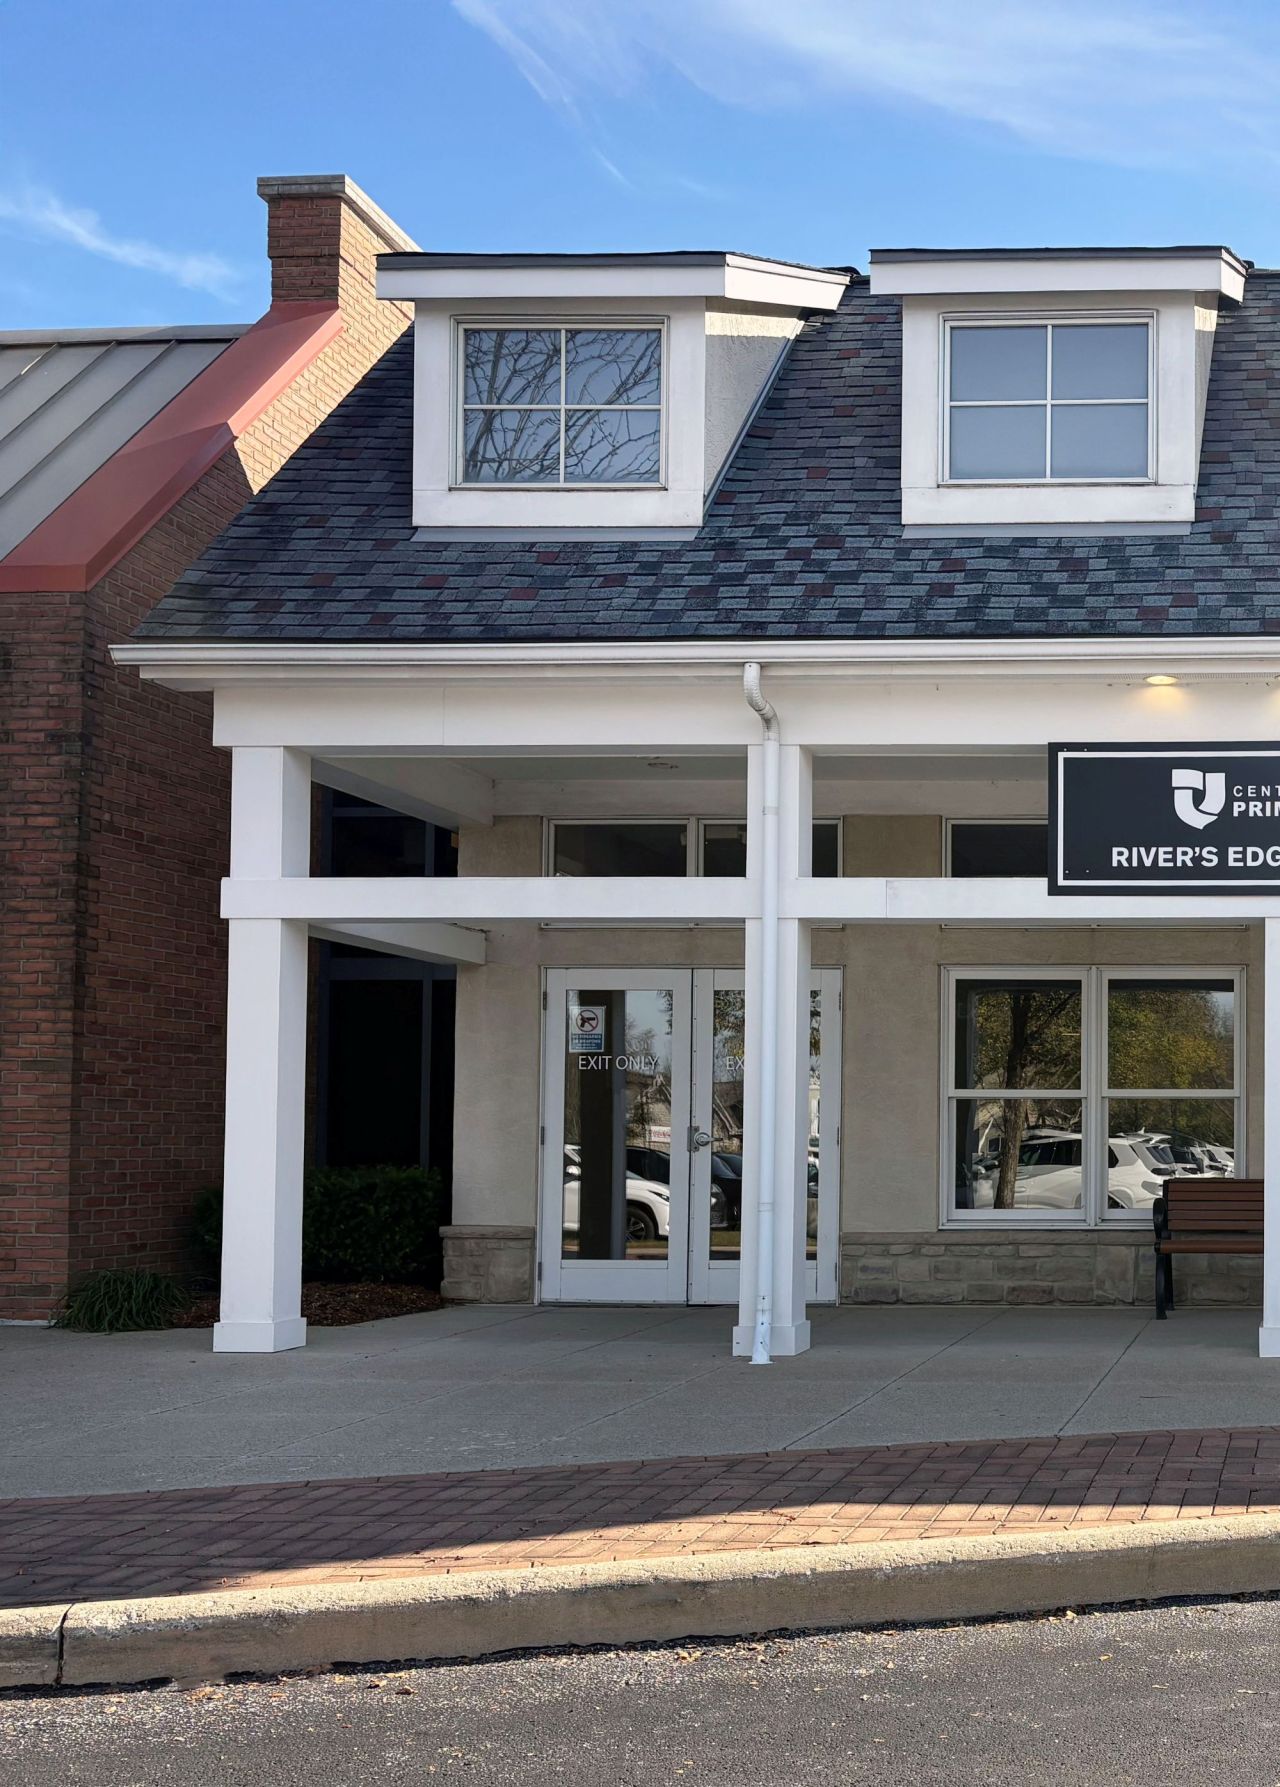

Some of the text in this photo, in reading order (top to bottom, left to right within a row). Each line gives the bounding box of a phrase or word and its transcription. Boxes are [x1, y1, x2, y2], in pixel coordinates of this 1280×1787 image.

[1111, 846, 1219, 868] RIVER'S
[578, 1055, 660, 1070] EXIT ONLY
[726, 1056, 746, 1070] EX
